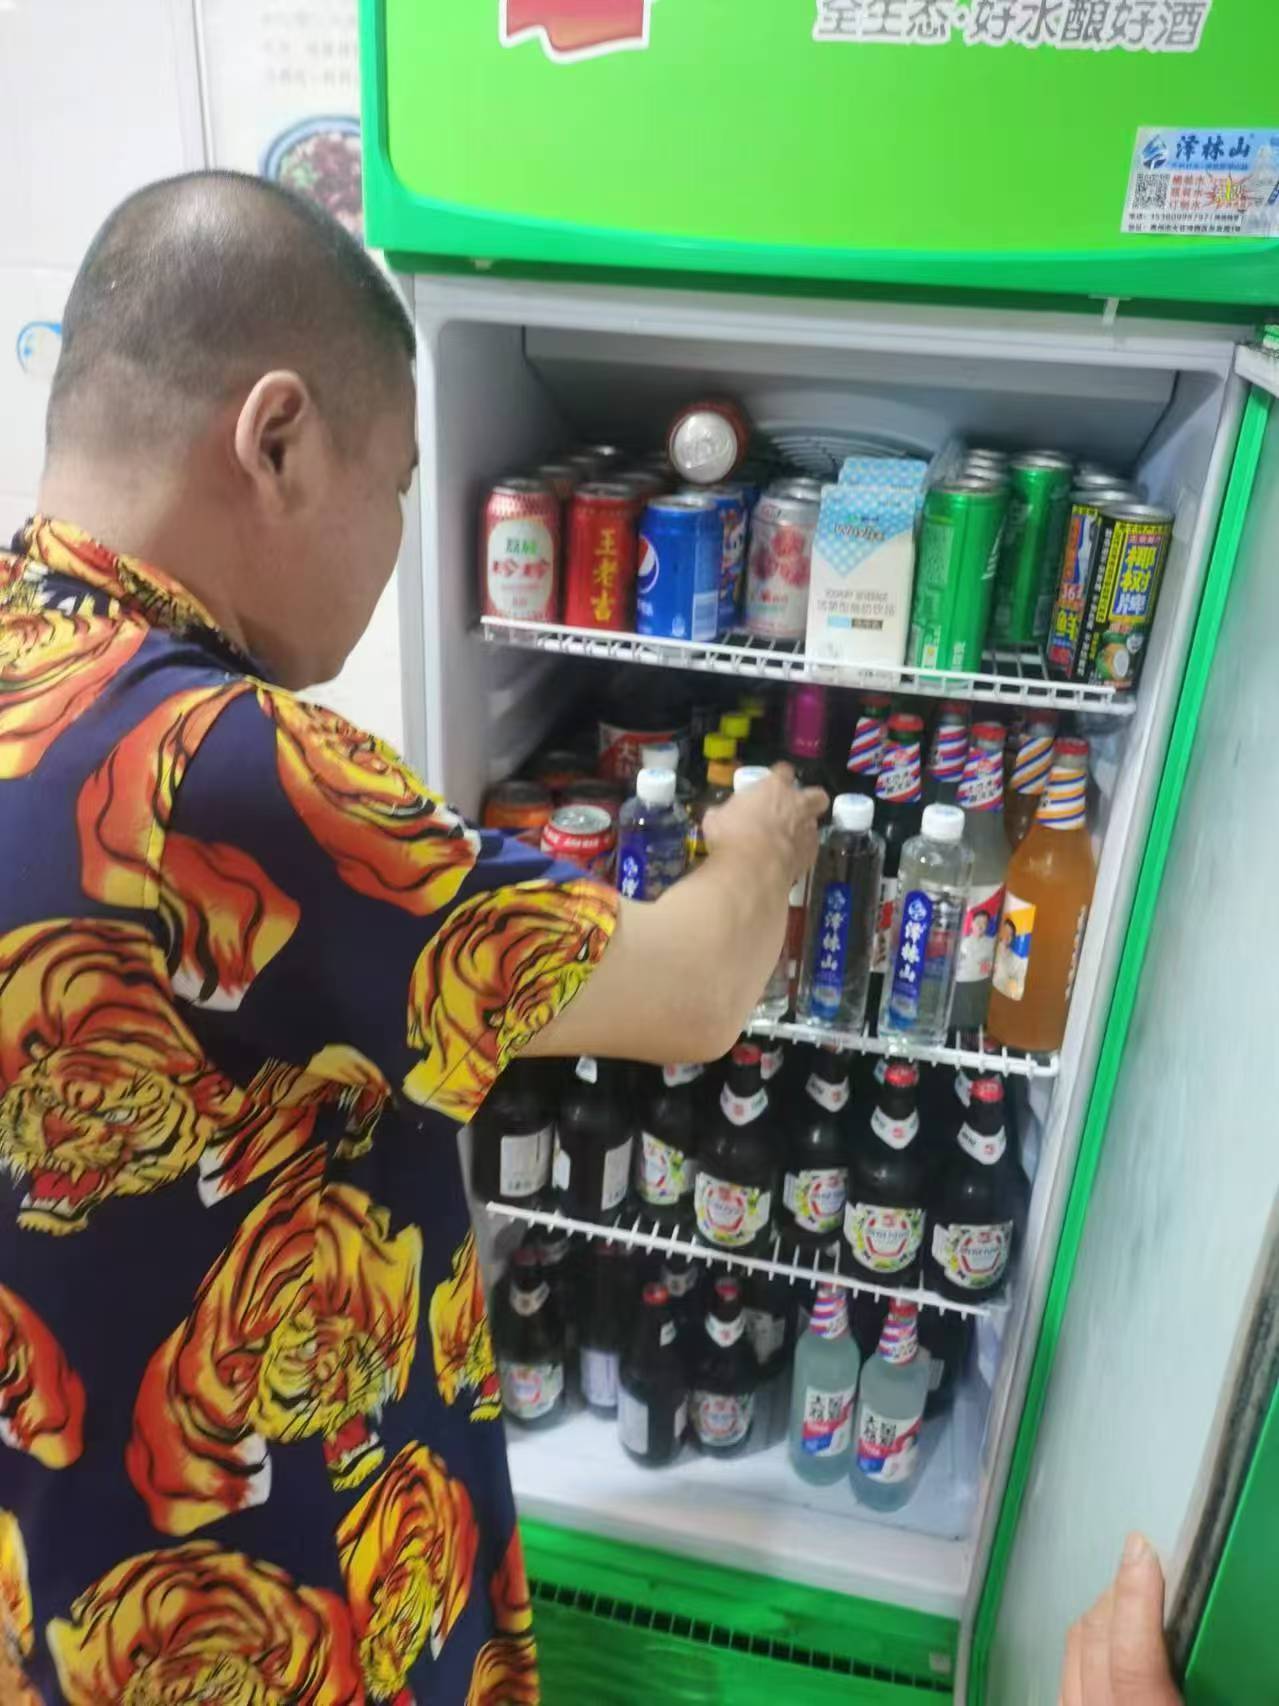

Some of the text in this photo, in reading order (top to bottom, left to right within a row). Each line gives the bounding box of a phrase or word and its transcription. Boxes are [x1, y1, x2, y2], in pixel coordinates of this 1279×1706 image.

[1175, 134, 1251, 161] 泽林山
[590, 527, 618, 622] 王老吉
[1113, 545, 1158, 617] 椰树牌
